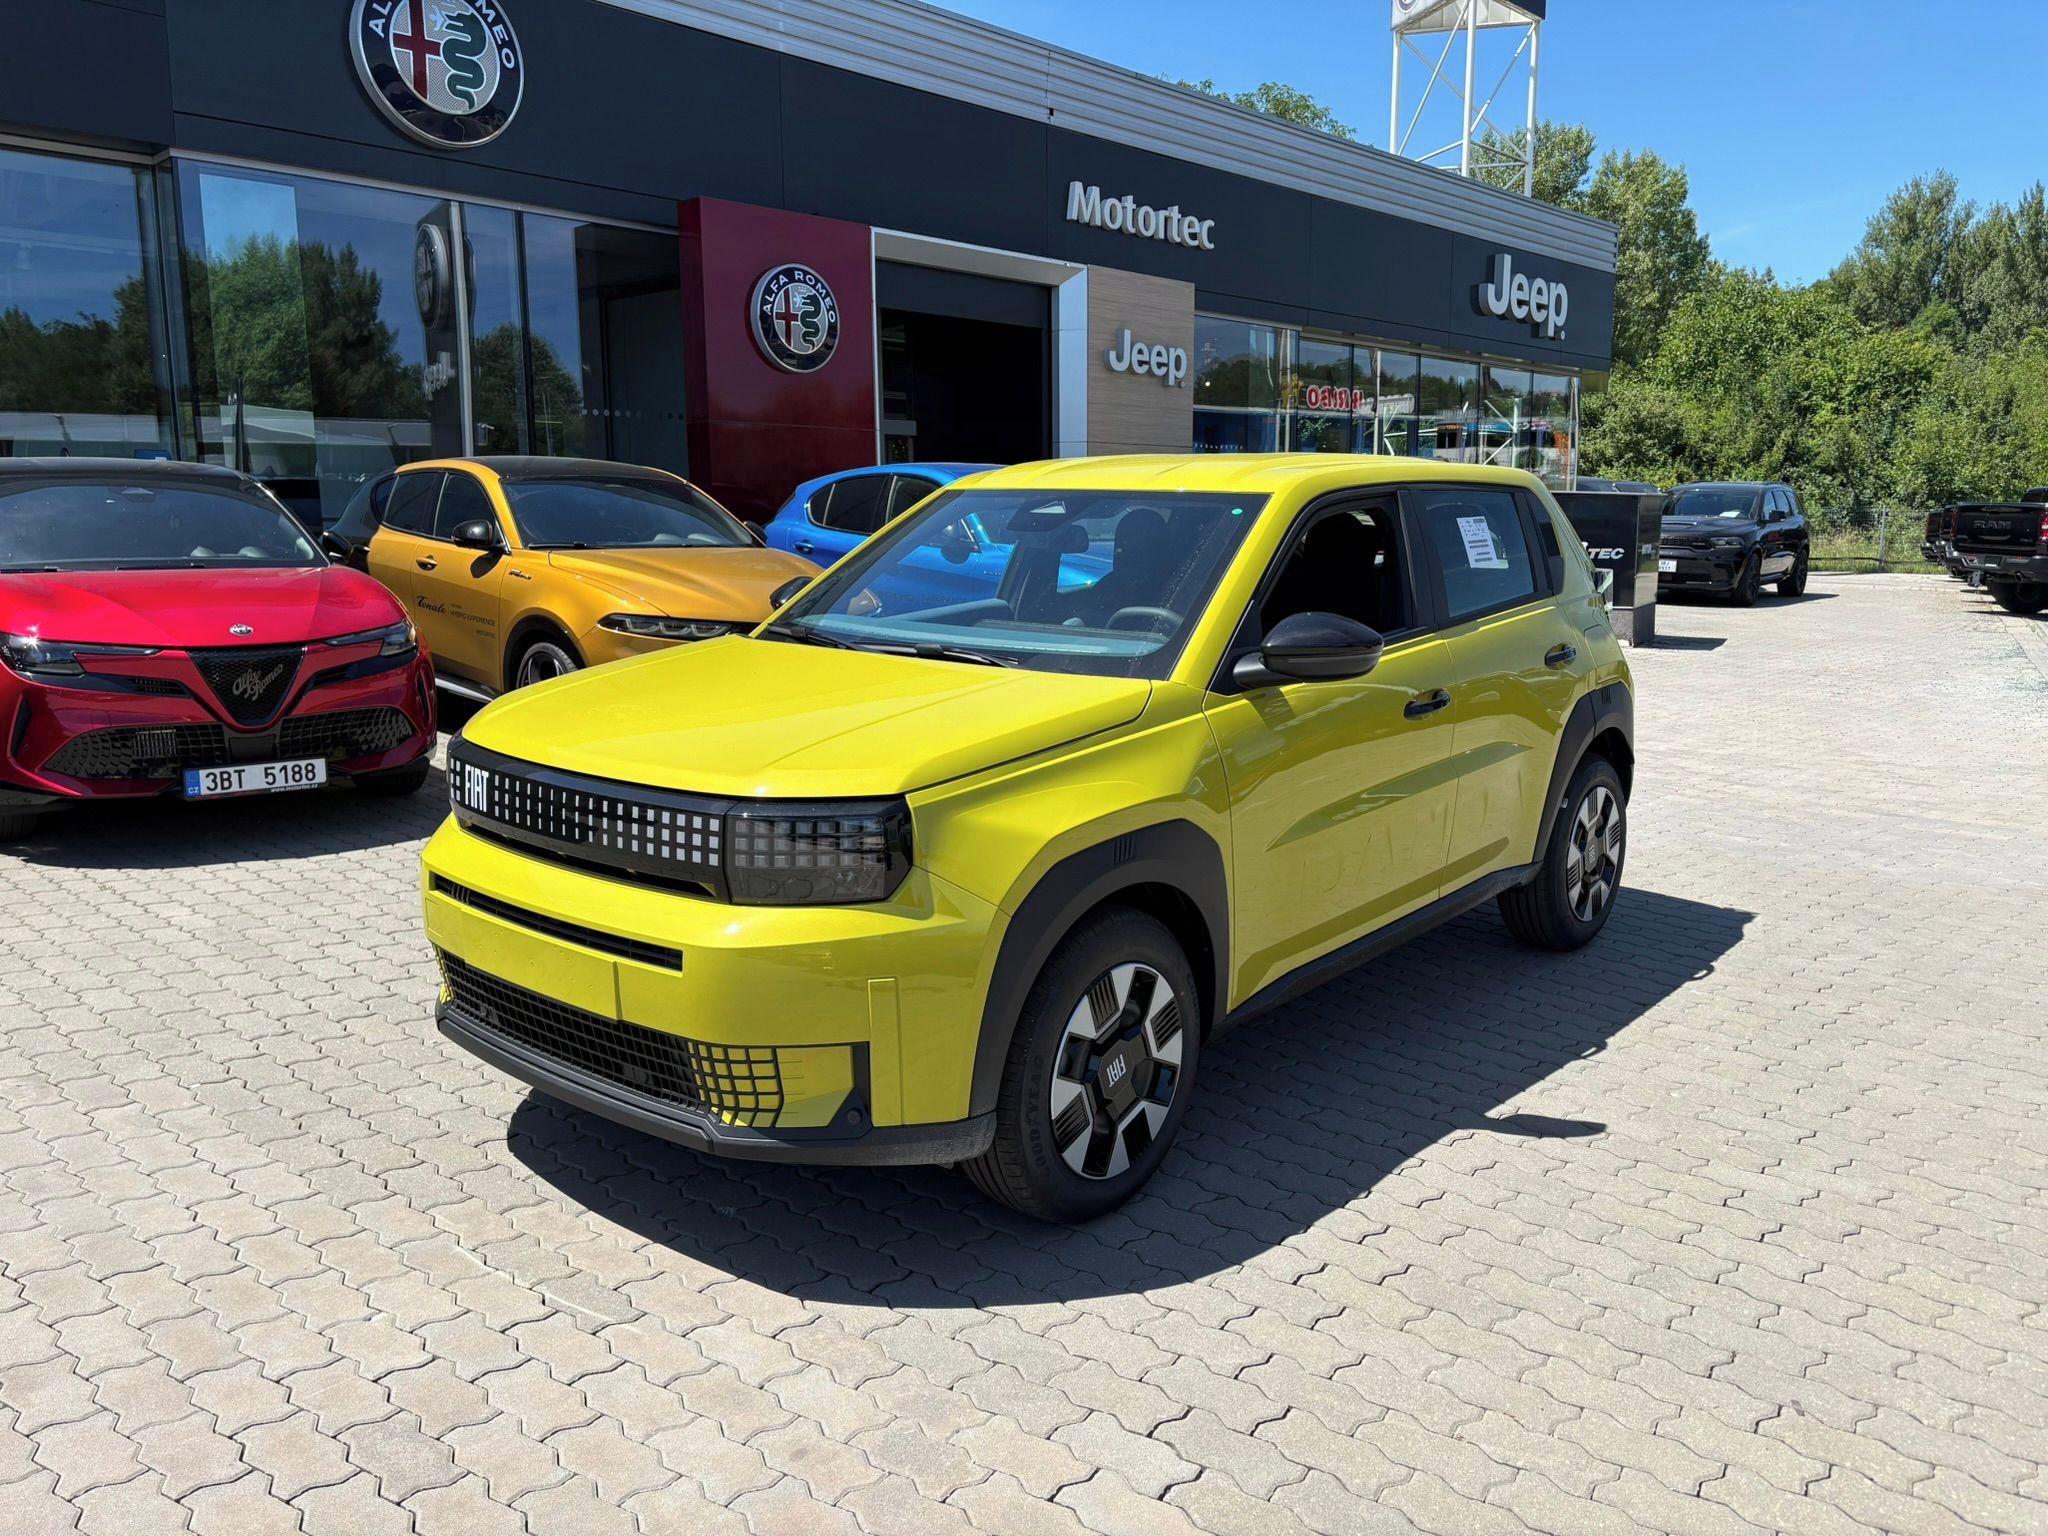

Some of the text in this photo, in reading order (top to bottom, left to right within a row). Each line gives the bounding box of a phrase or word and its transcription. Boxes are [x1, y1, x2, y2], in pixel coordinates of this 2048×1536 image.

[368, 0, 515, 69] AL MEO
[1066, 180, 1216, 250] Motortec
[762, 270, 836, 323] ALFA ROMEO
[1484, 252, 1569, 338] Jeep
[1107, 328, 1188, 386] Jeep
[416, 595, 448, 614] Tonale
[188, 786, 200, 794] CZ
[204, 762, 317, 792] 3BT 5188
[465, 764, 489, 813] FIAT
[1106, 1053, 1127, 1088] FIAT
